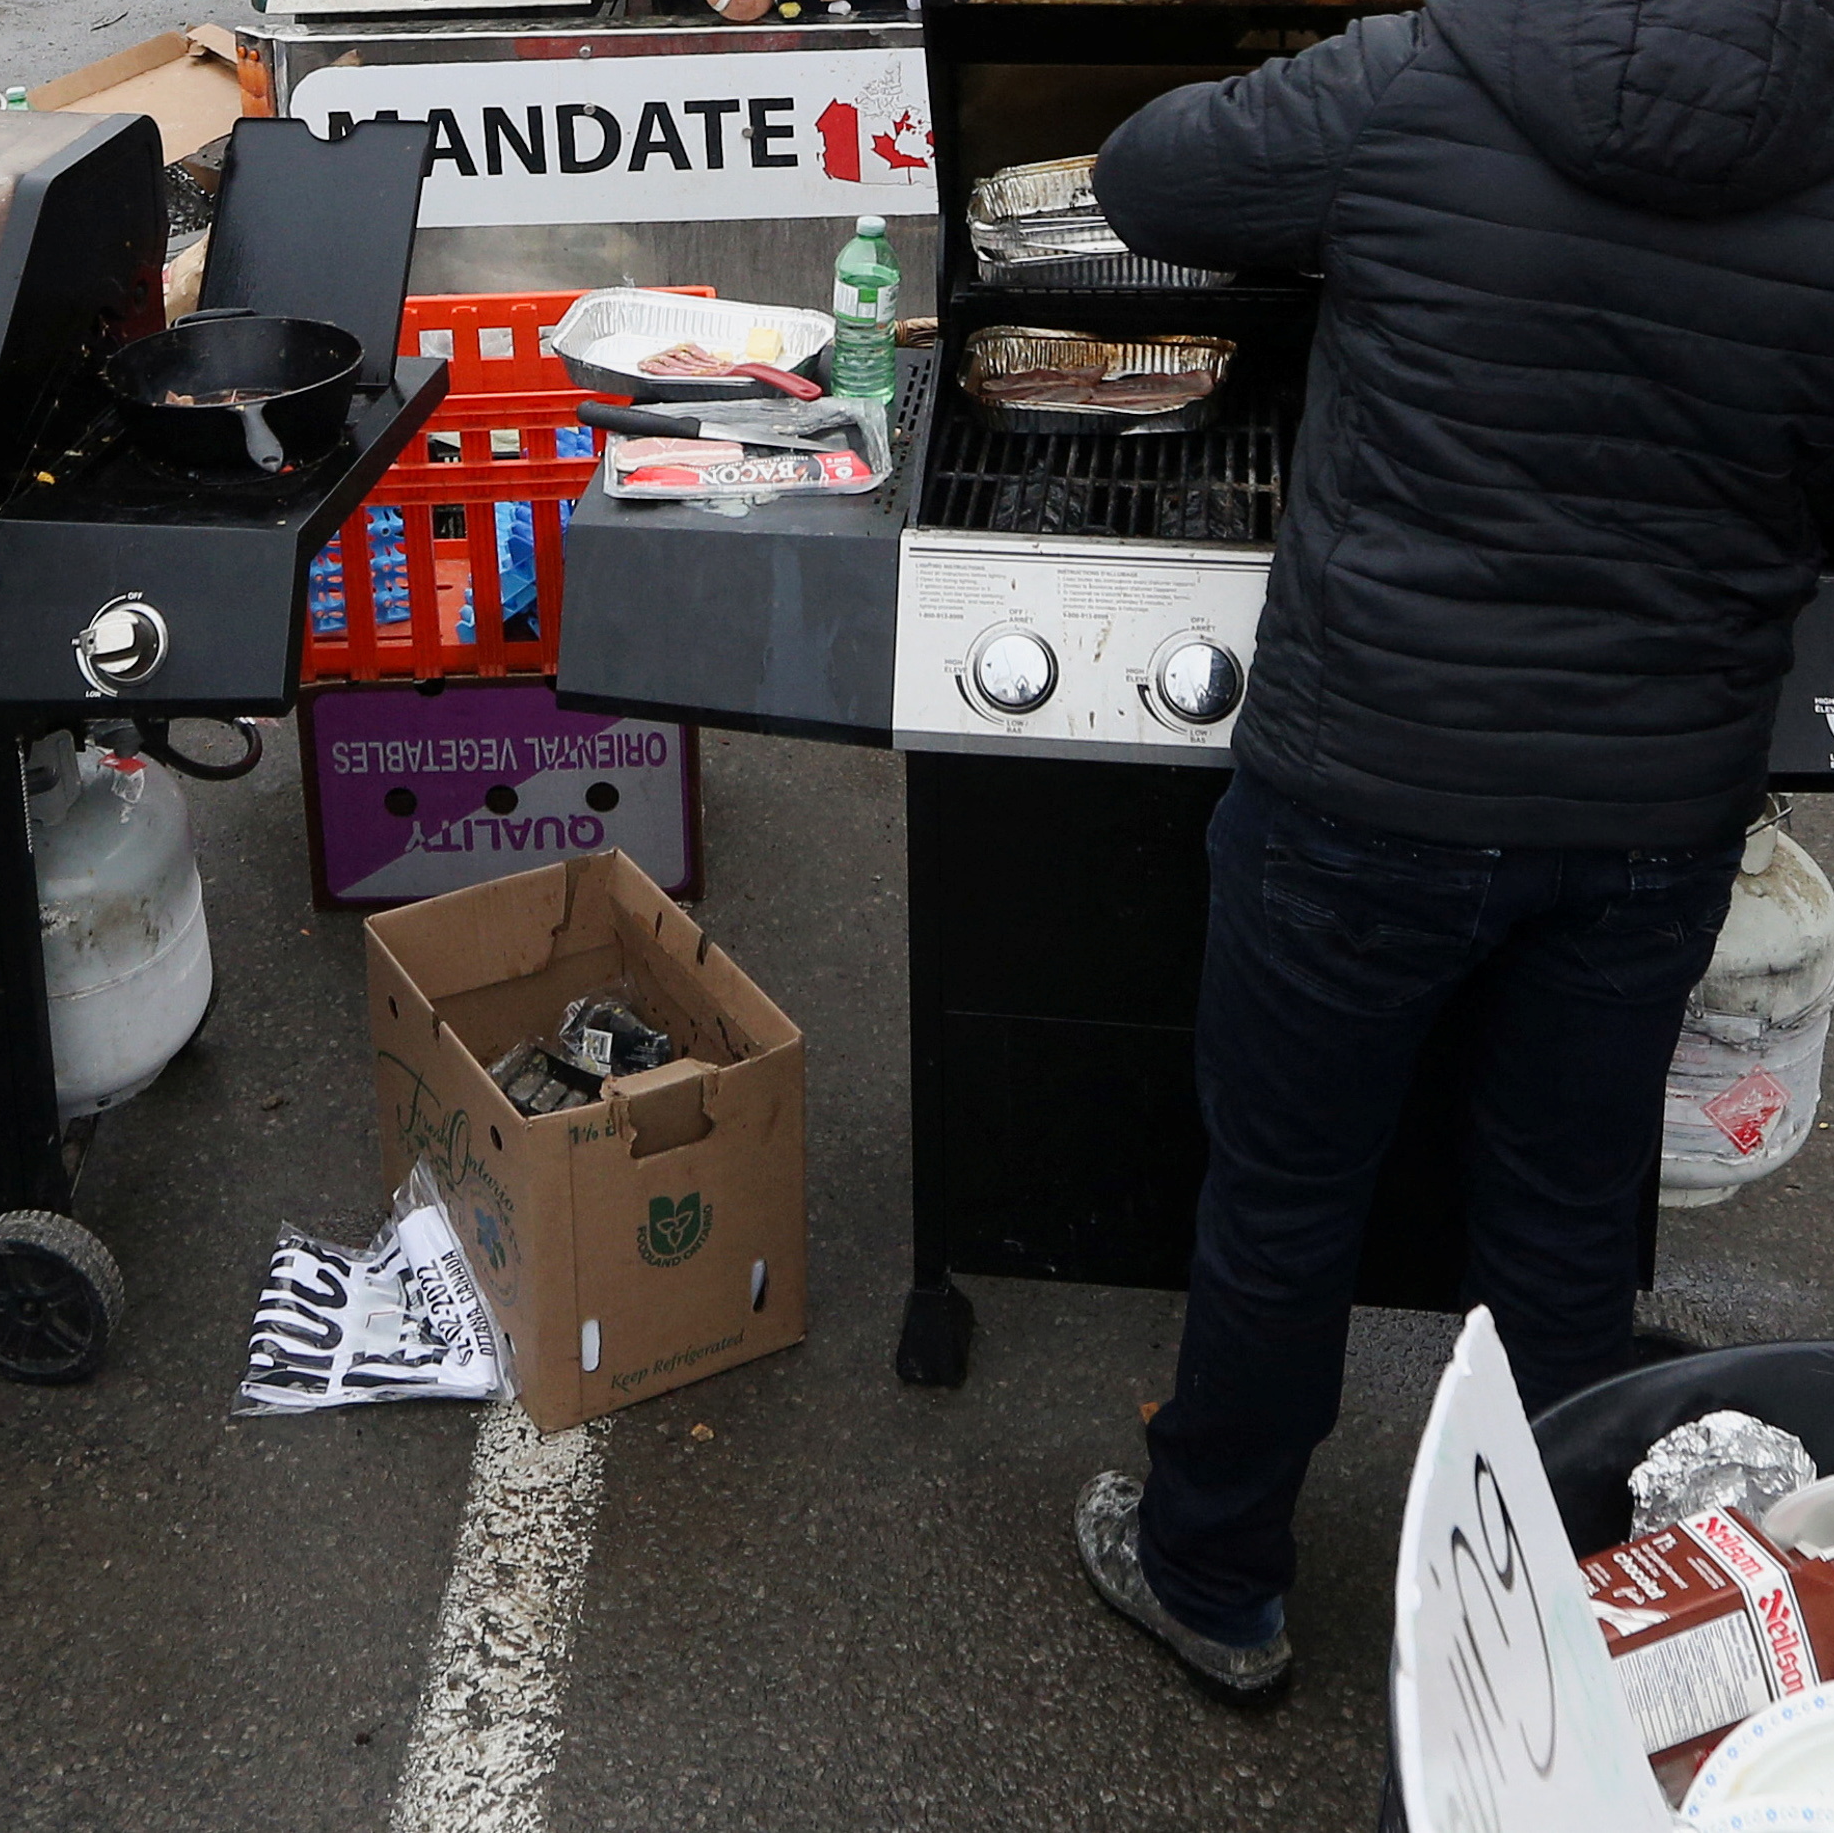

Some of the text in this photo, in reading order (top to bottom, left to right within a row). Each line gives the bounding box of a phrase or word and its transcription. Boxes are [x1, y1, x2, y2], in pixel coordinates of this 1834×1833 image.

[326, 97, 800, 178] ANDATE
[698, 460, 797, 485] BACON
[127, 591, 143, 600] OFF
[331, 732, 667, 774] ORIENTAL VEGETABLES
[404, 814, 605, 853] QUALITY
[447, 1108, 516, 1212] Ontario
[636, 1203, 714, 1269] FOODLAND ONTARIO
[441, 1249, 476, 1303] CANADA
[610, 1328, 746, 1394] Keep Refrigerated
[1613, 1552, 1668, 1600] chocolat
[1695, 1516, 1765, 1582] Neilson
